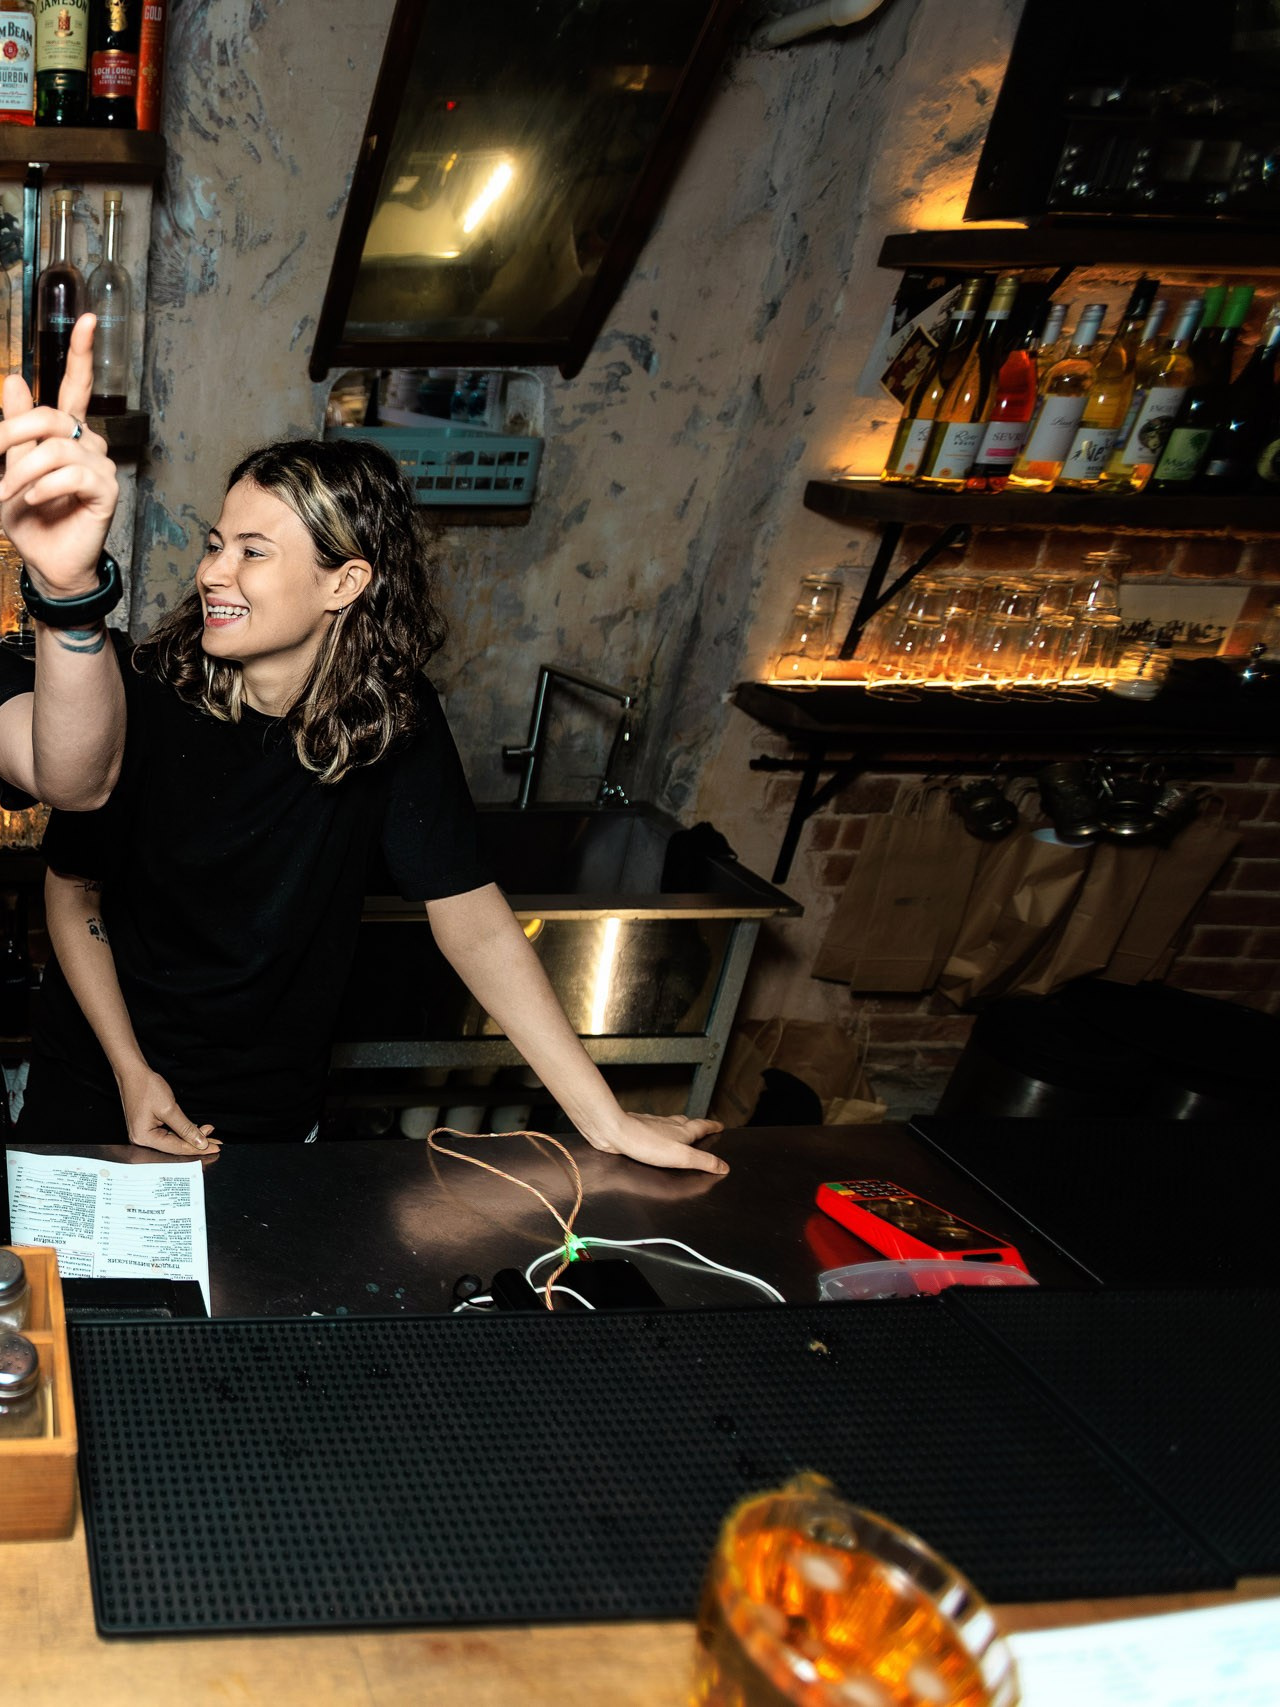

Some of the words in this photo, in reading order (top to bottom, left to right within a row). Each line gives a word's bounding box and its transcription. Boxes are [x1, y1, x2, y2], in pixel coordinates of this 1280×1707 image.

[144, 5, 162, 20] GOLD
[7, 21, 33, 47] BEAM
[94, 66, 110, 76] LOCH
[112, 67, 136, 77] LOMOND
[33, 1237, 67, 1245] КОКТЕЙЛИ
